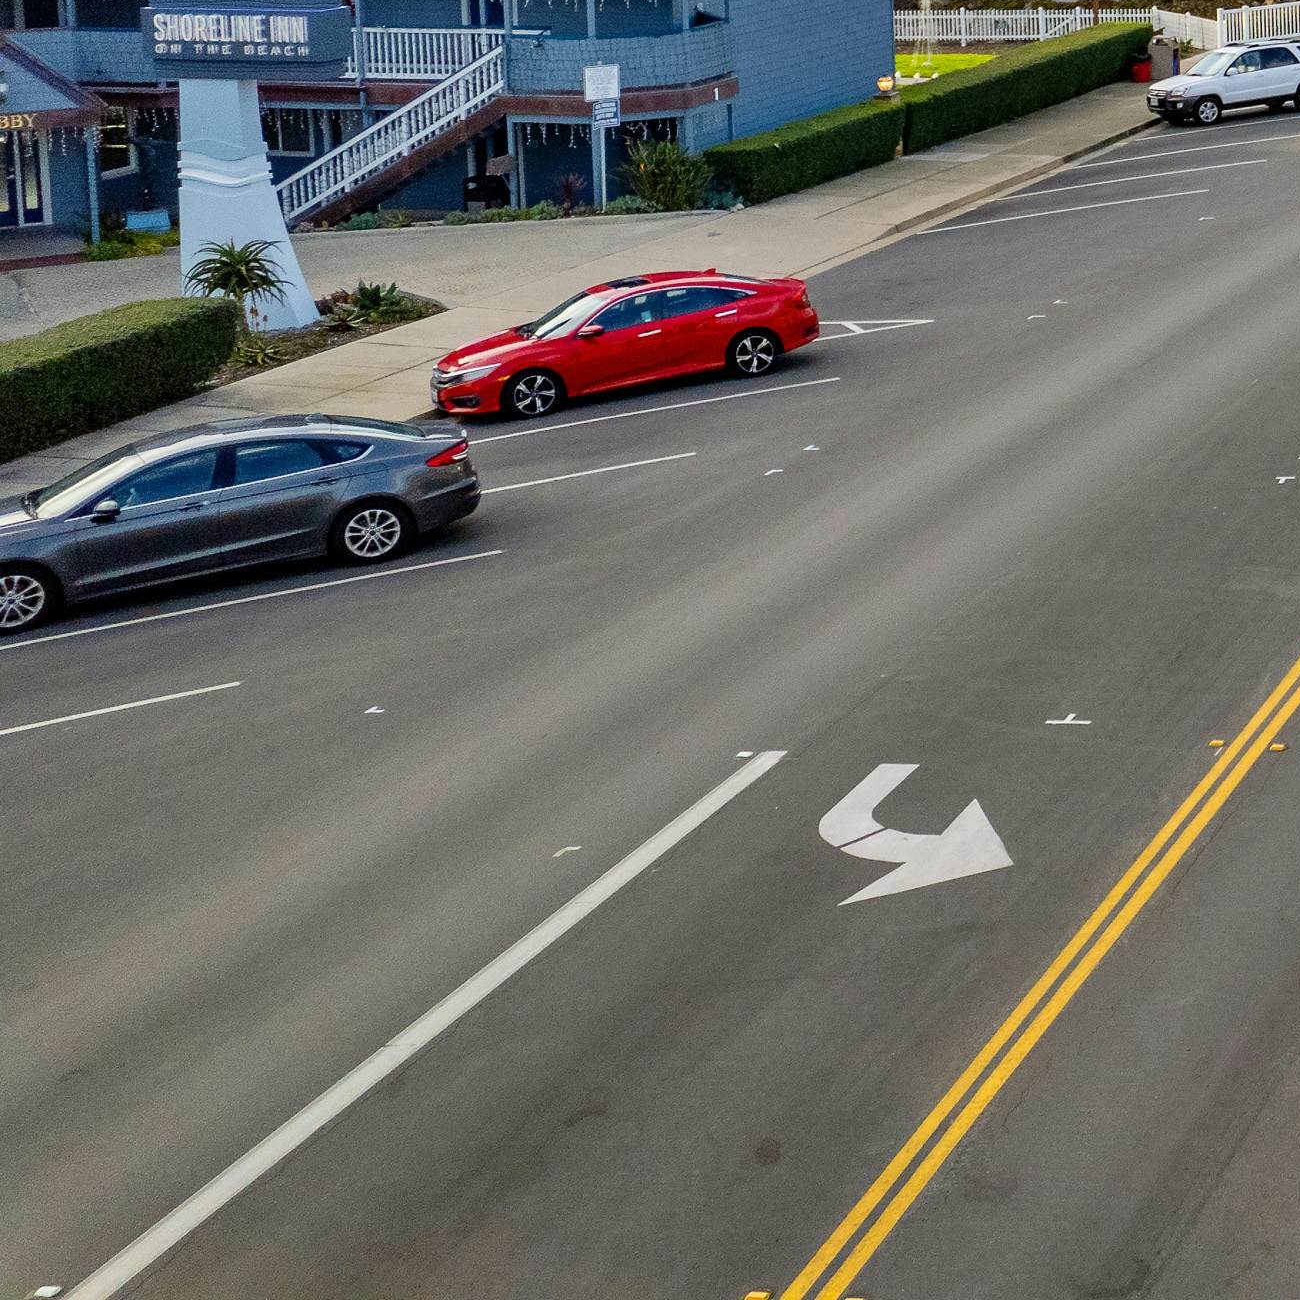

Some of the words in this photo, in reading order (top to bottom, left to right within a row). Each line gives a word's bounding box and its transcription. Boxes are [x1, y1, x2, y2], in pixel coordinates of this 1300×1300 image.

[153, 13, 266, 43] SHORELINE
[269, 15, 308, 44] INN
[155, 43, 182, 54] ON
[194, 44, 232, 55] THE
[243, 44, 310, 56] BEACH
